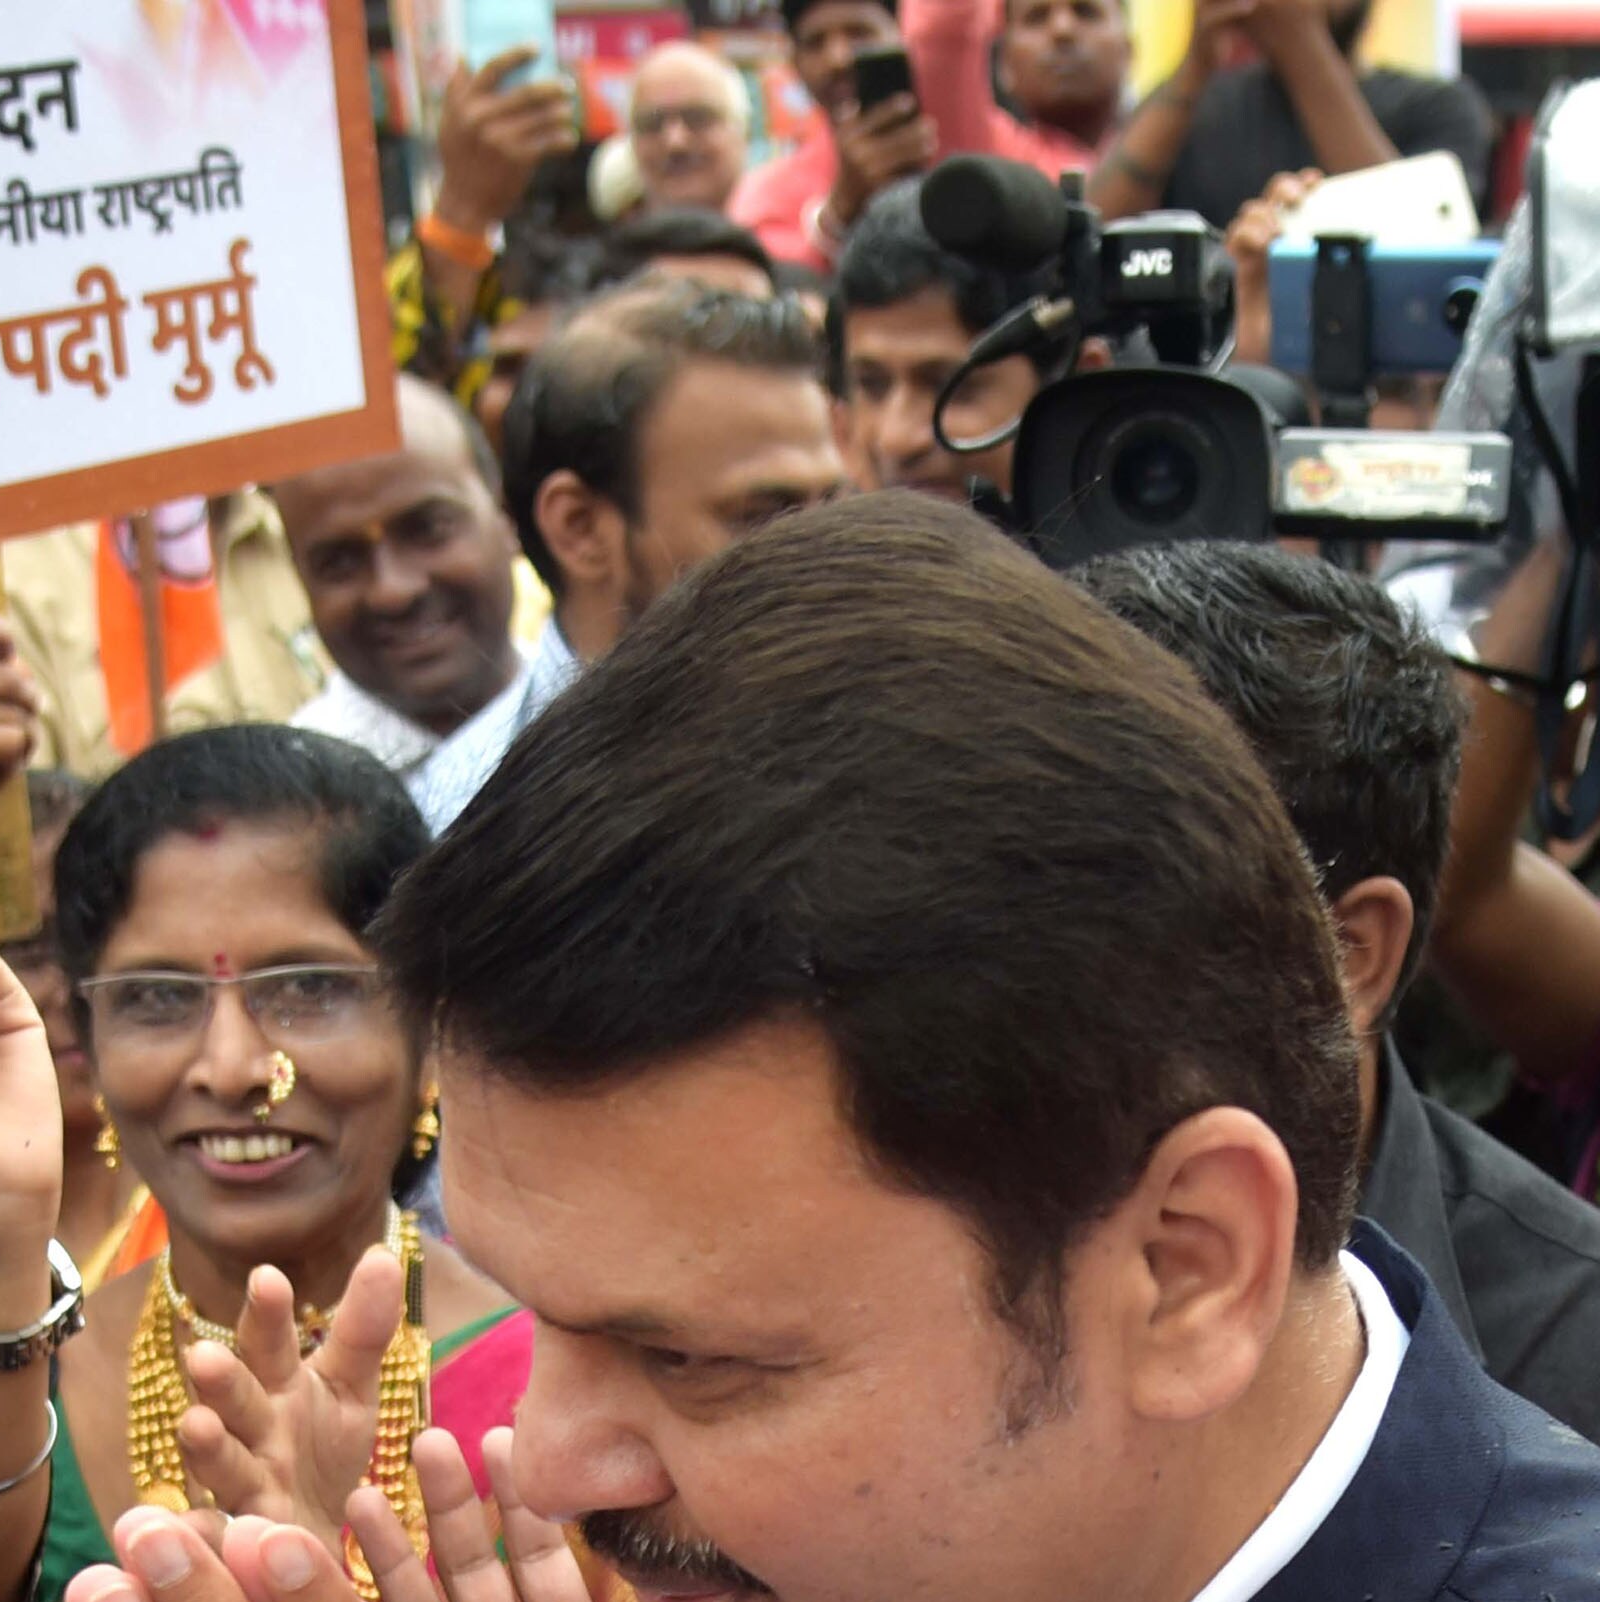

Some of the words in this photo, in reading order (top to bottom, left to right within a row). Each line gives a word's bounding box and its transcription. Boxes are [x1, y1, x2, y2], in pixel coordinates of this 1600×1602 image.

[93, 147, 243, 233] राष्ट्रपति
[1121, 248, 1173, 276] JVC
[142, 238, 274, 403] मुर्मू
